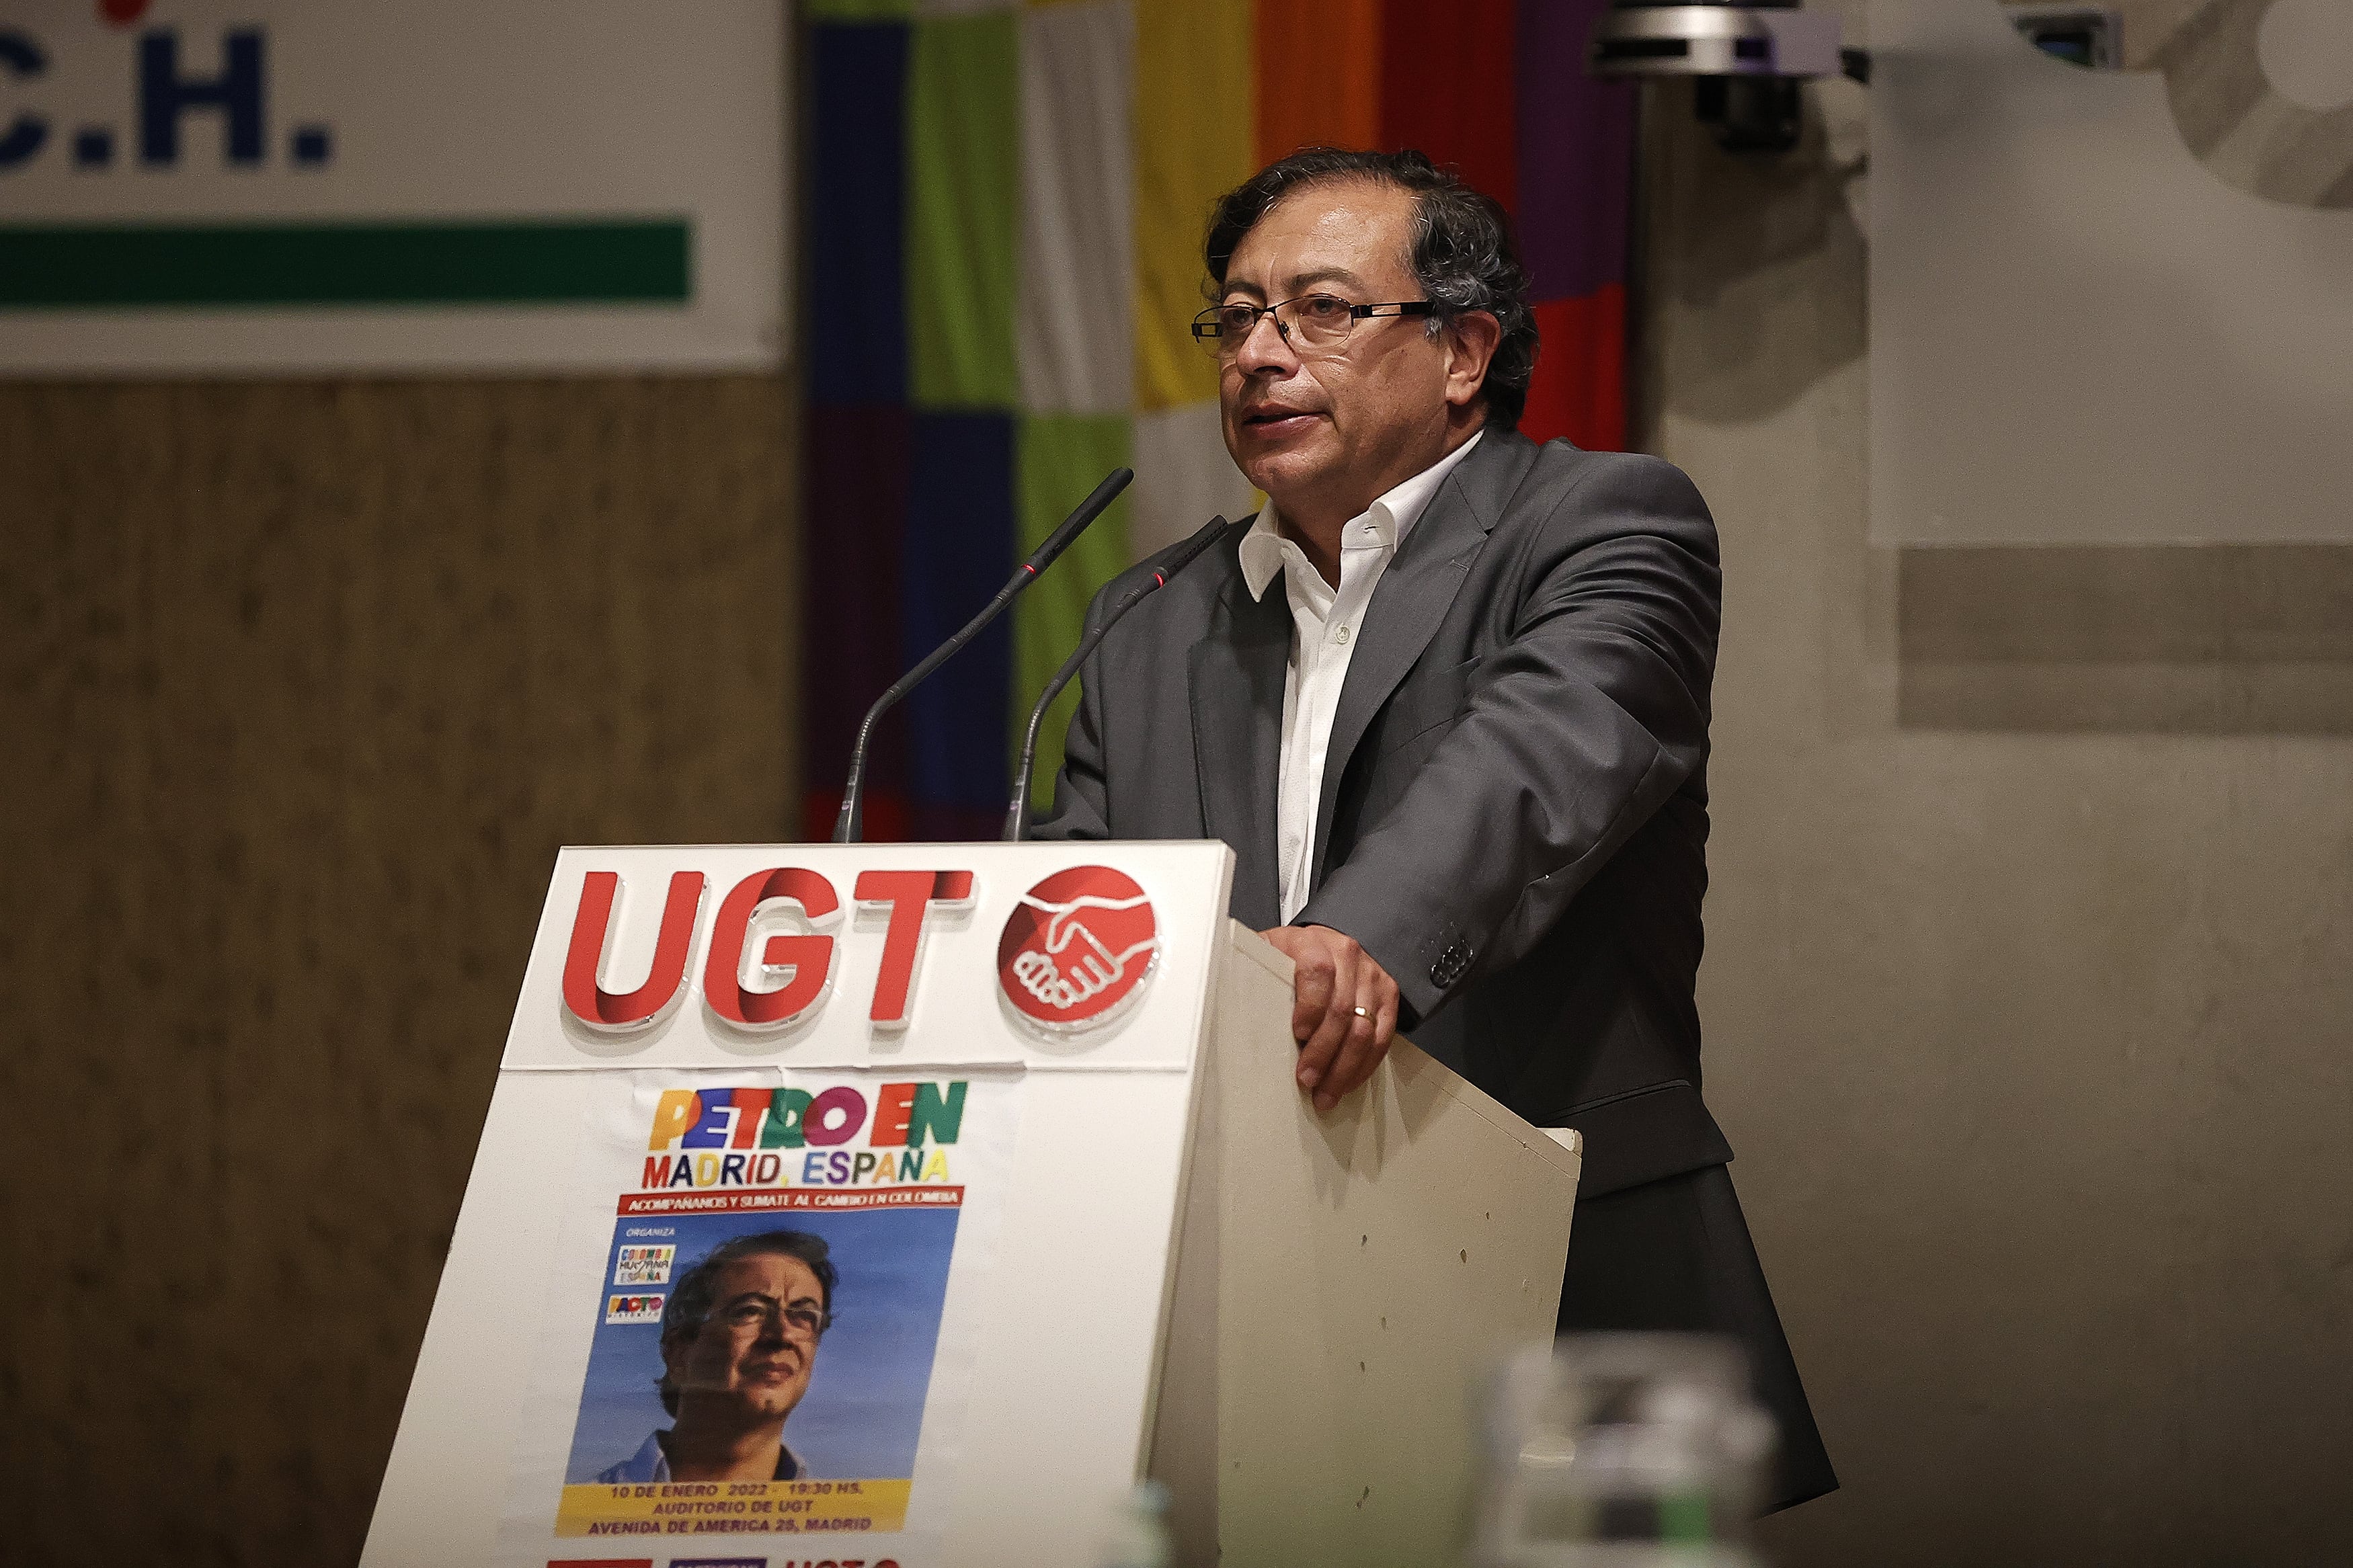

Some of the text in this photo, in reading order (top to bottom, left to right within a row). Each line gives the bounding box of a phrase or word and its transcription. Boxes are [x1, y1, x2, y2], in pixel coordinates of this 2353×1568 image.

[561, 867, 978, 1028] UGT
[648, 1081, 968, 1151] PETRO EN
[641, 1146, 948, 1189] MADRID, ESPAÑA
[729, 1196, 739, 1207] Y
[794, 1194, 809, 1206] AL
[627, 1227, 676, 1237] ORGANIZA
[609, 1296, 664, 1313] PACTO
[612, 1486, 630, 1499] 10
[635, 1485, 655, 1498] DE
[661, 1484, 719, 1497] ENERO
[728, 1484, 768, 1496] 2022
[653, 1499, 813, 1514] AUDITORIO DE UGT
[588, 1521, 660, 1535] AVENIDA
[668, 1520, 689, 1533] DE
[805, 1518, 872, 1531] MADRID
